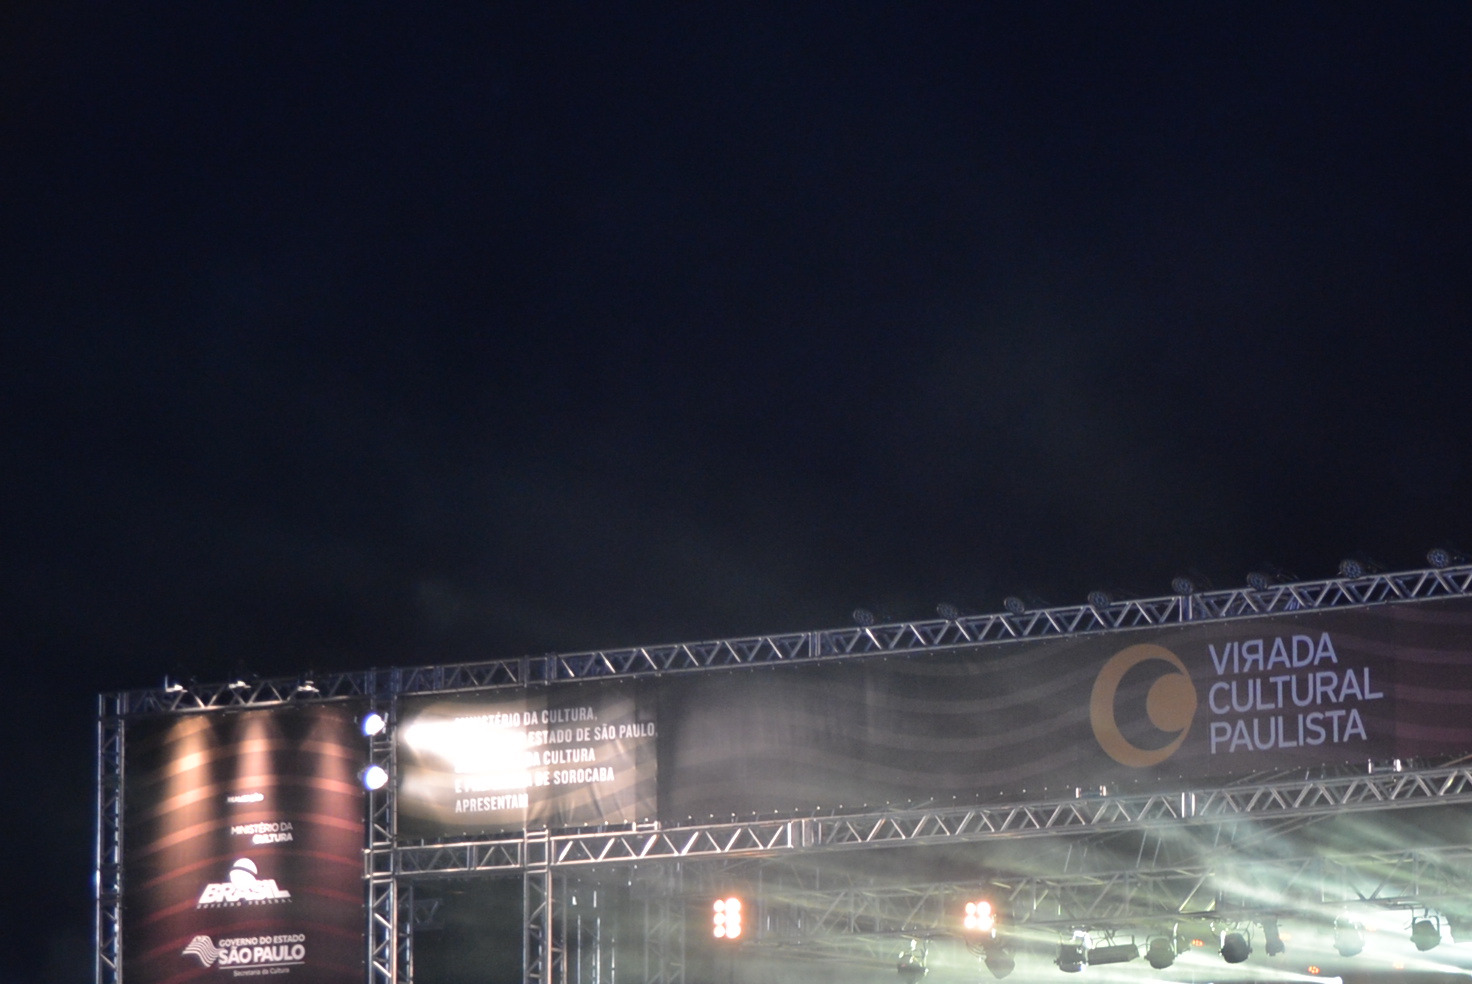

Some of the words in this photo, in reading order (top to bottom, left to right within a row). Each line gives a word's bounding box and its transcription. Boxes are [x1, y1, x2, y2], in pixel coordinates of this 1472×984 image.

[1208, 667, 1384, 715] CULTURAL
[523, 710, 538, 726] DA
[542, 707, 598, 724] CULTURA,
[526, 728, 572, 746] ESTADO
[576, 727, 590, 742] DE
[594, 723, 616, 741] SÃO
[619, 722, 658, 739] PAULO,
[1210, 708, 1368, 754] PAULISTA
[543, 748, 596, 766] CULTURA
[534, 771, 550, 786] DE
[553, 766, 614, 785] SOROCABA
[455, 793, 528, 813] APRESENTAM
[280, 822, 293, 832] DA
[218, 936, 258, 948] GOVERNO
[260, 936, 272, 945] DO
[273, 934, 306, 944] ESTADO
[218, 946, 252, 965] SÃO
[253, 944, 306, 963] PAULO
